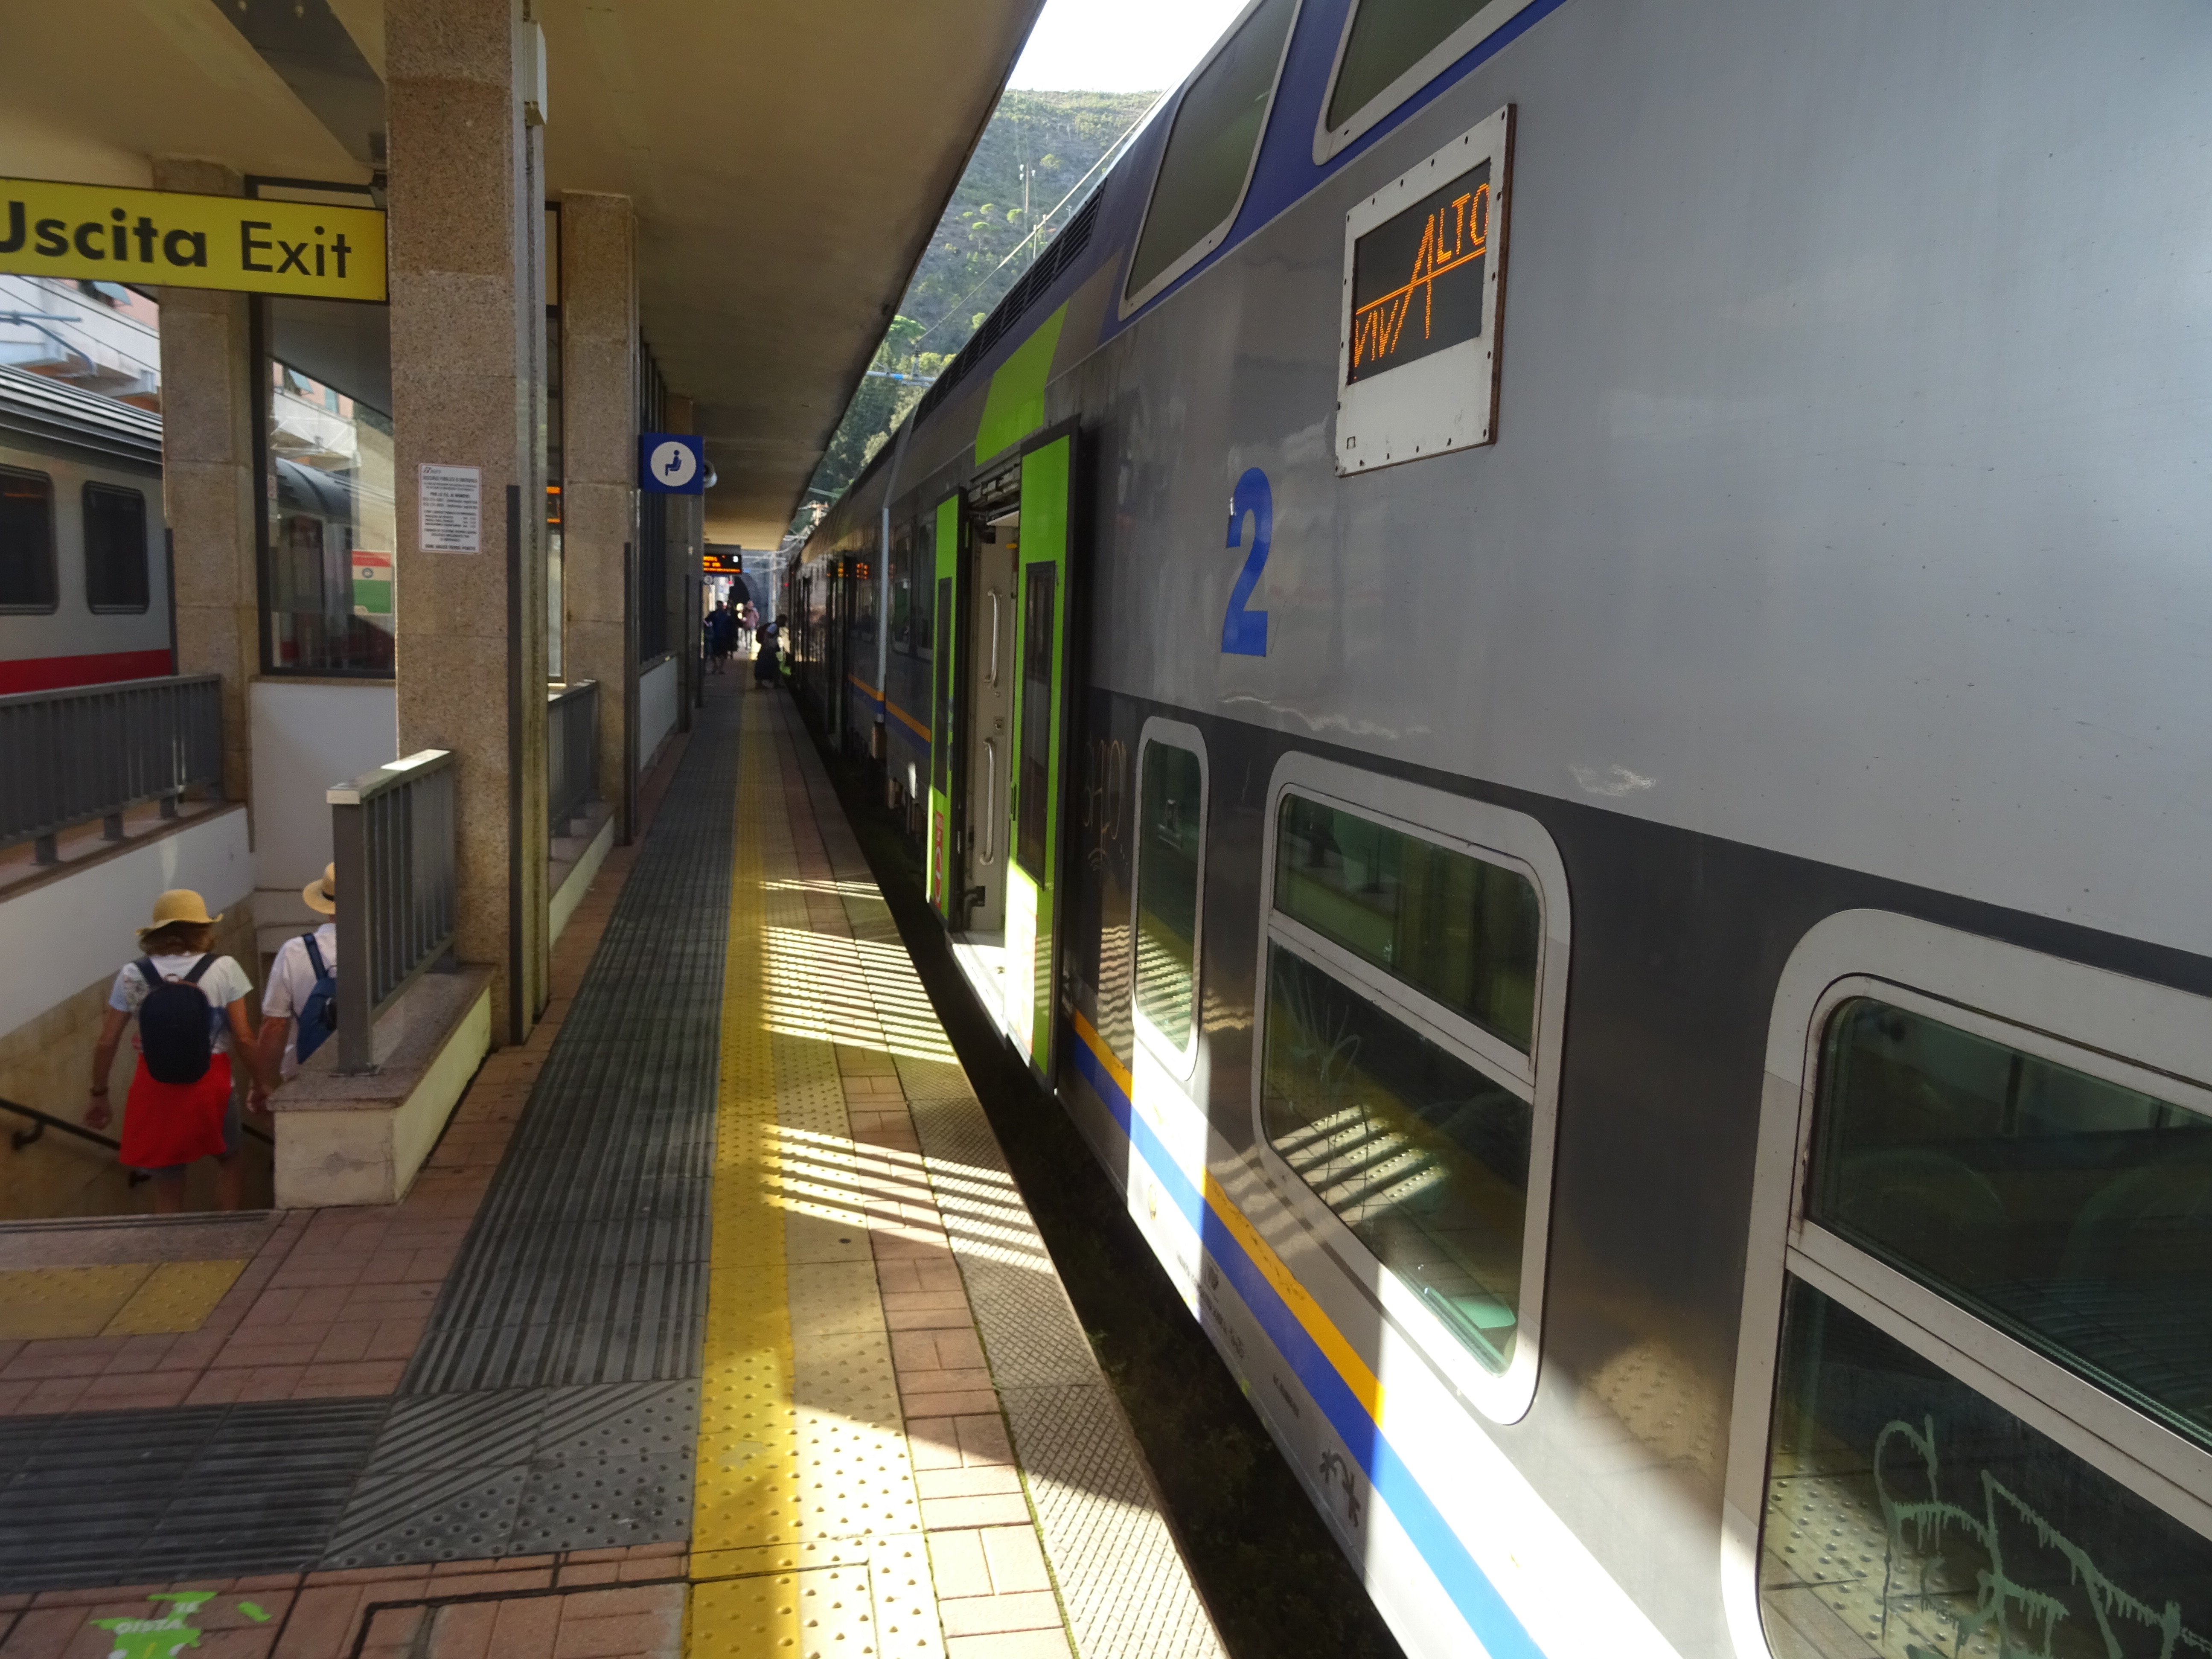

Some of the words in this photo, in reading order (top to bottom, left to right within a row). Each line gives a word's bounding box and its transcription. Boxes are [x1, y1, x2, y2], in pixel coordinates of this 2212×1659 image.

[0, 201, 207, 268] Uscita
[240, 220, 352, 278] Exit
[1221, 467, 1272, 657] 2
